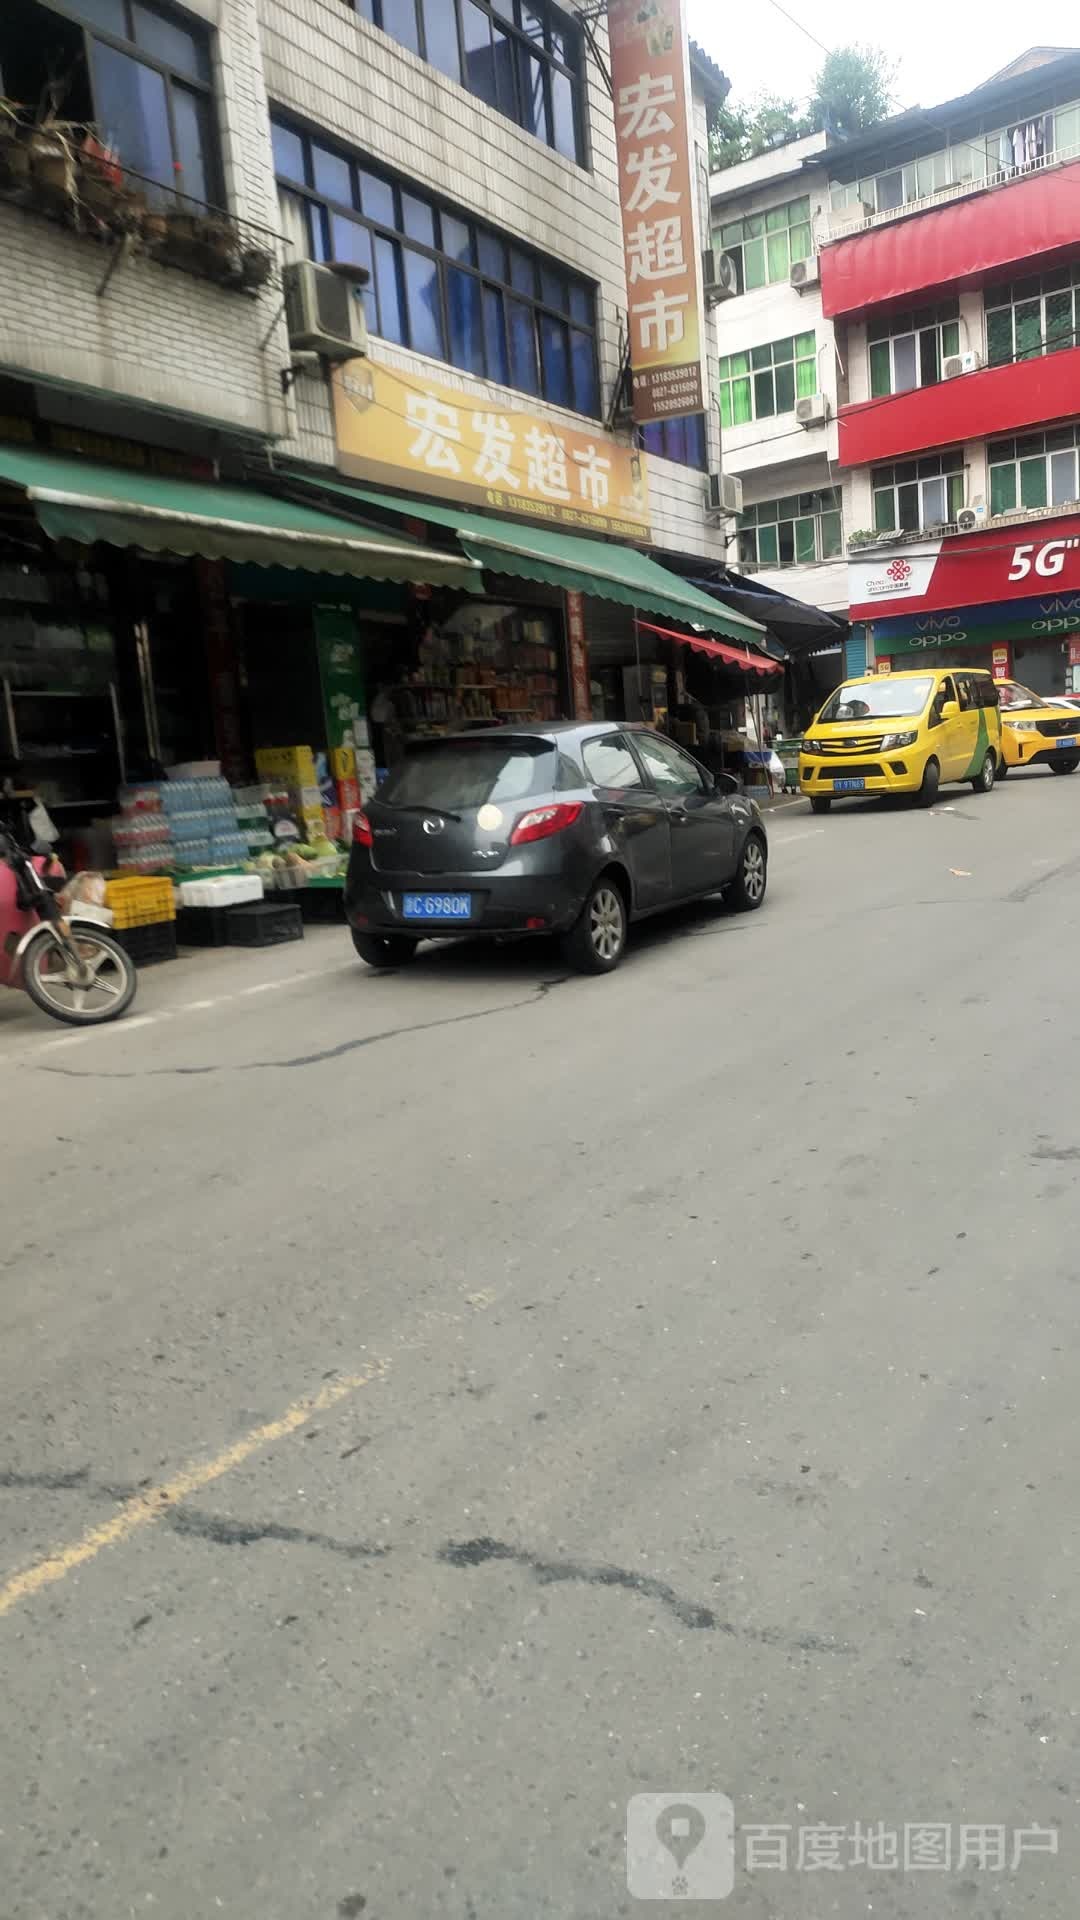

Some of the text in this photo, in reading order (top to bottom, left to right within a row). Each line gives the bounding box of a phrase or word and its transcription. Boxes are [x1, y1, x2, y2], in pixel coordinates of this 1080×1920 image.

[617, 72, 688, 351] 宏发超市
[404, 389, 610, 509] 宏发超市
[908, 632, 967, 647] oppo
[916, 615, 961, 630] vivo
